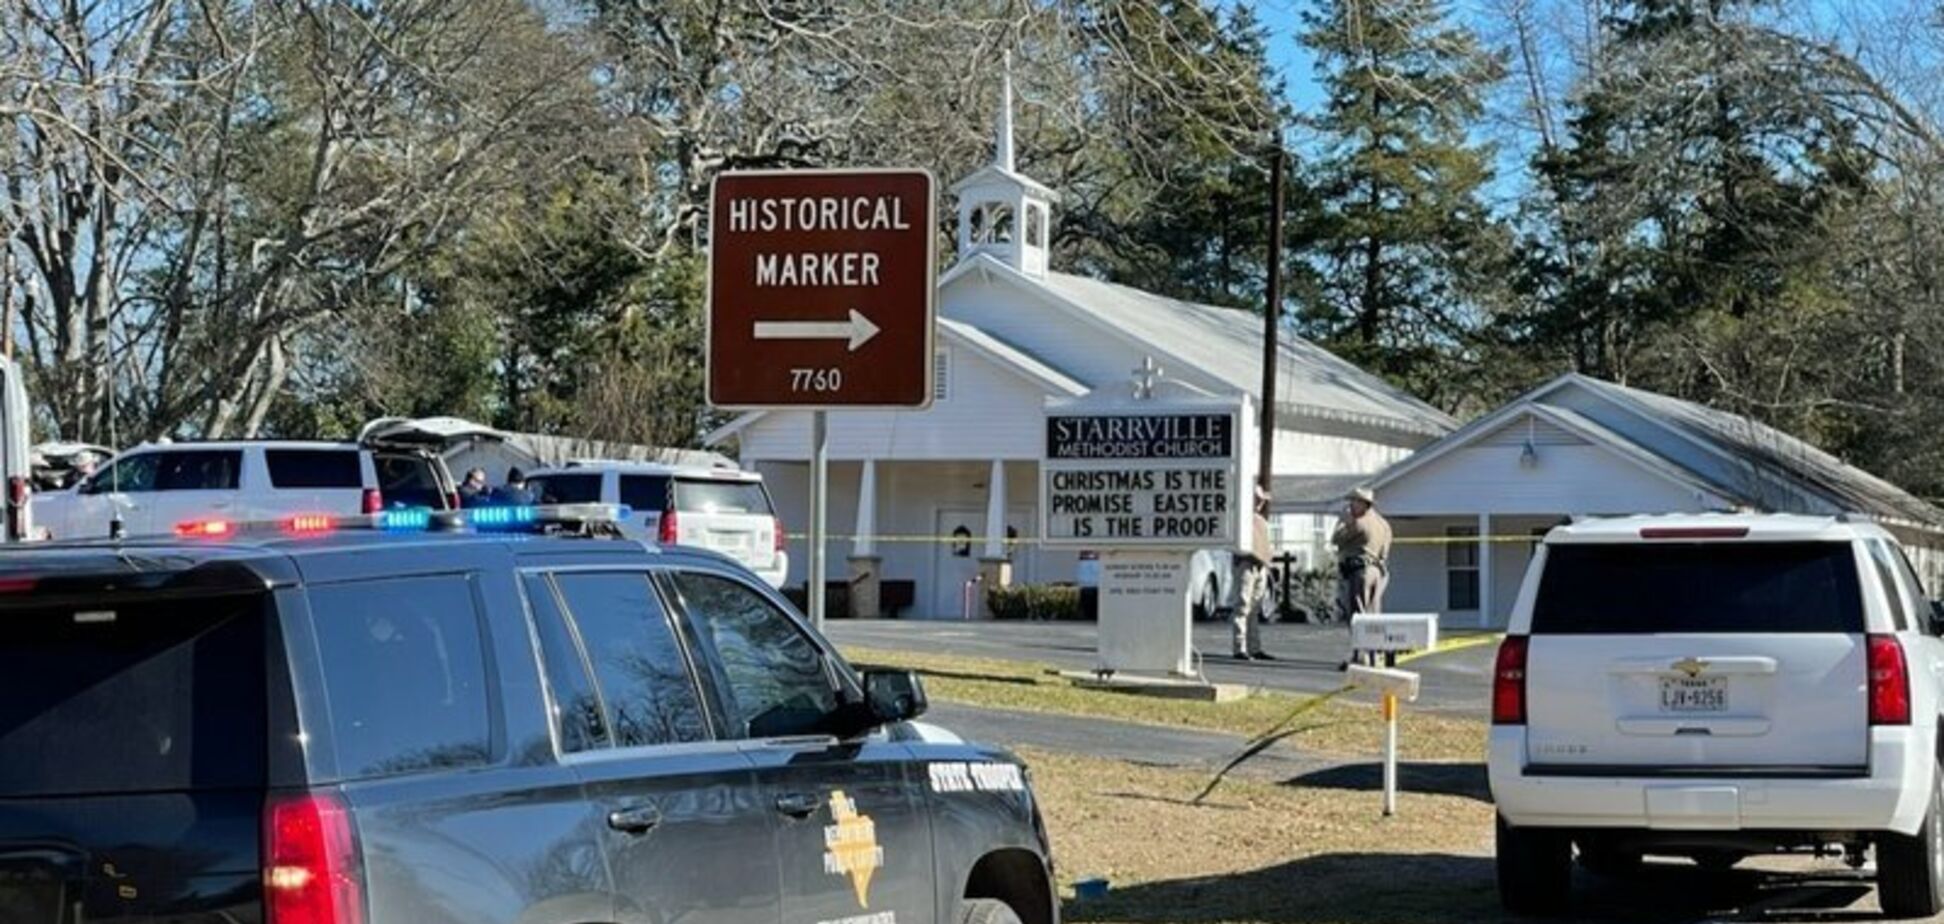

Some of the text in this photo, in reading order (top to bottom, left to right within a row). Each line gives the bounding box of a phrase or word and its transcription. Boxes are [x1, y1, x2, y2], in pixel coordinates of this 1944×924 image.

[729, 196, 911, 232] HISTORICAL
[756, 253, 880, 286] MARKER
[789, 367, 842, 392] 7760
[1056, 416, 1222, 441] STARRVILLE
[1057, 441, 1222, 457] METHODIST CHURCH
[1053, 470, 1226, 490] CHRISTMAS IS THE
[1053, 493, 1226, 513] PROMISE EASTER
[1073, 517, 1219, 537] IS THE PROOF
[929, 763, 973, 791] STATE
